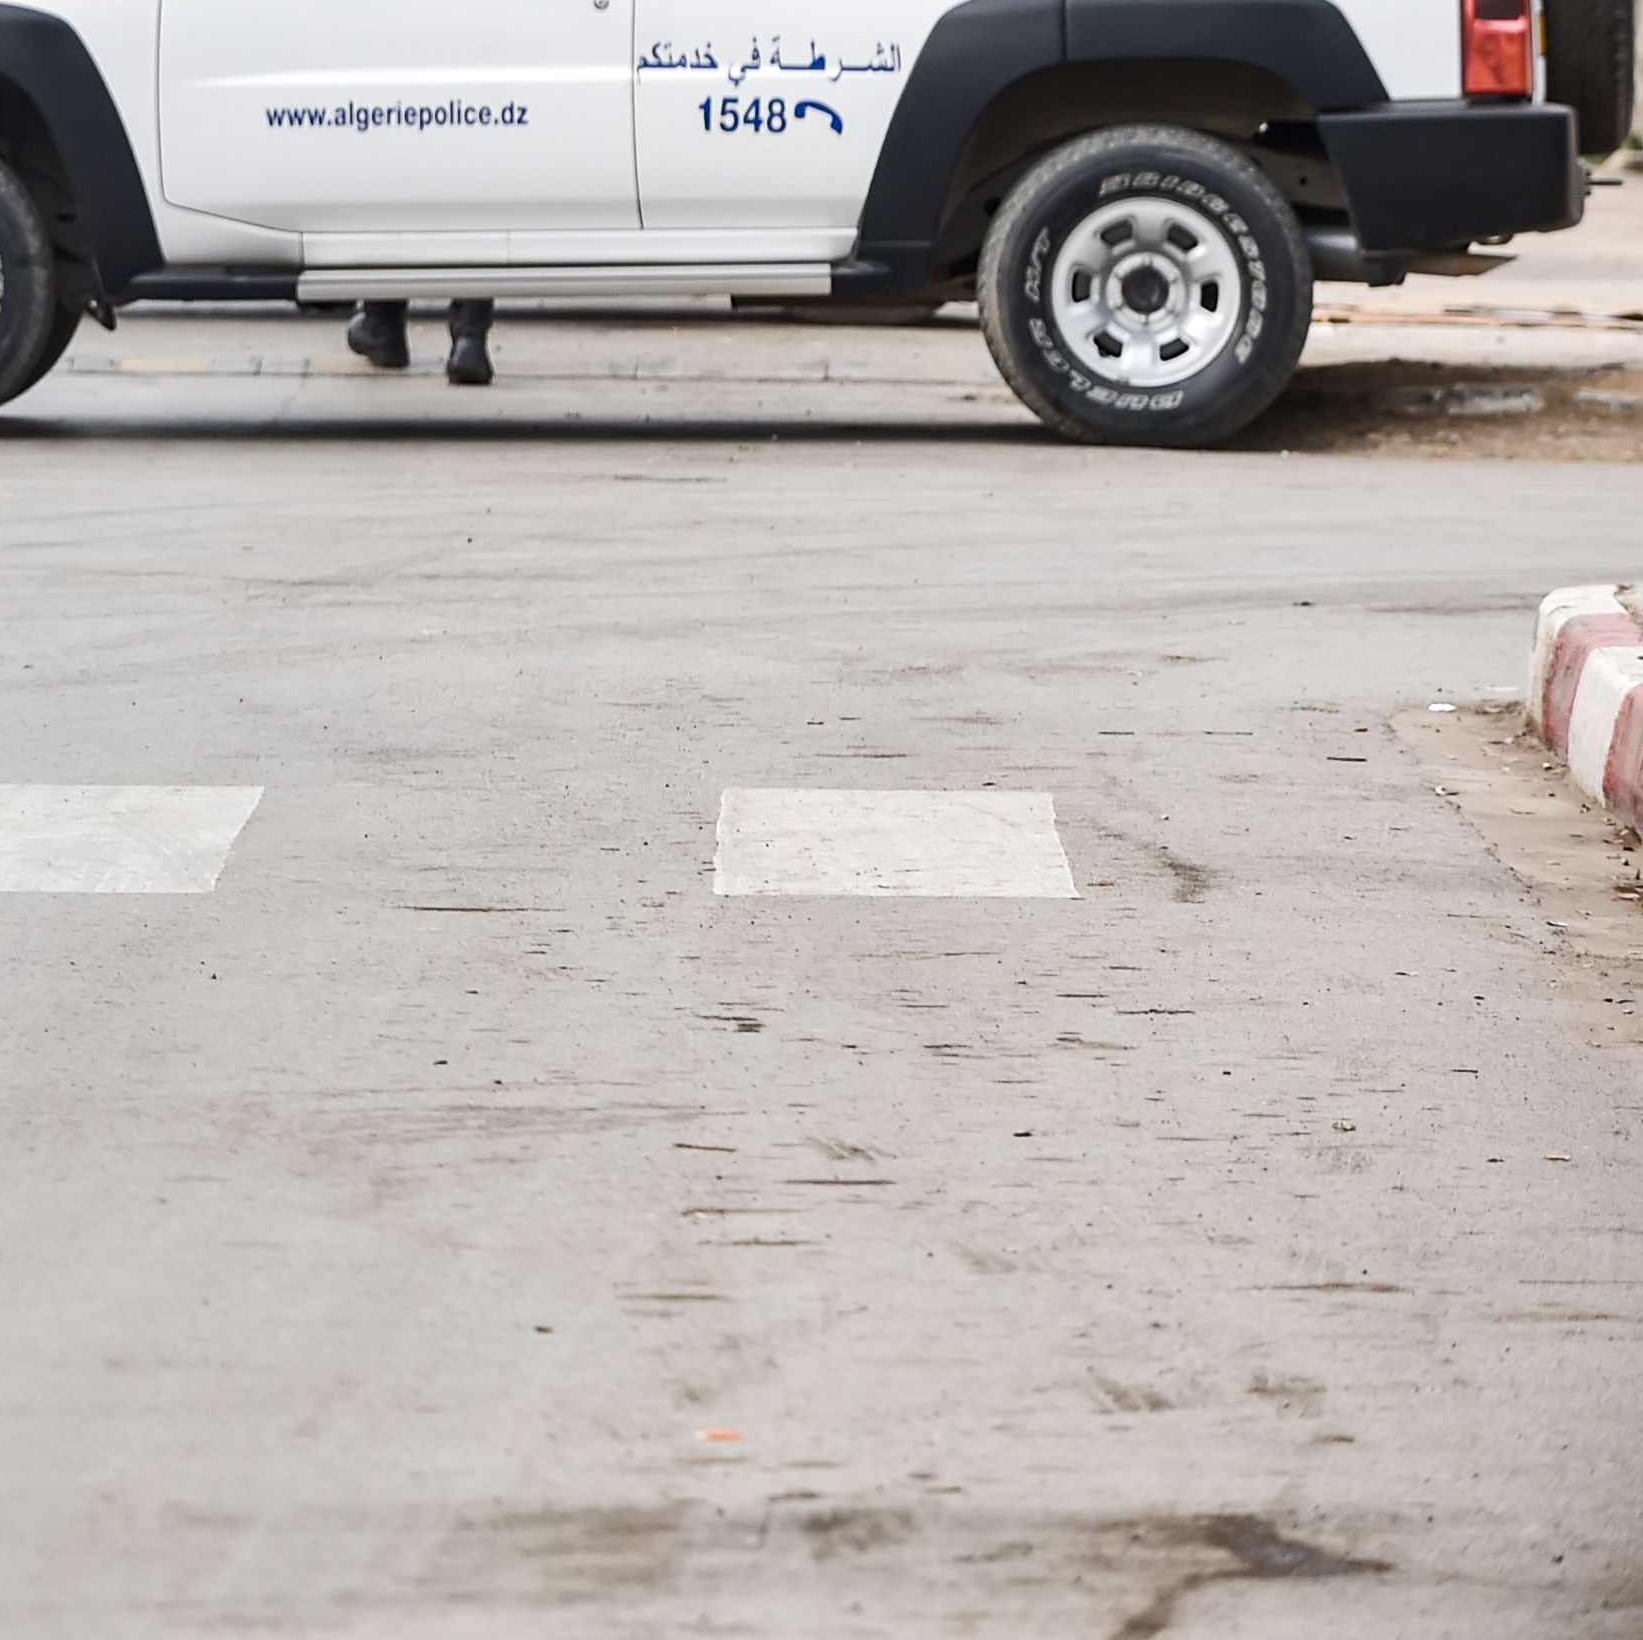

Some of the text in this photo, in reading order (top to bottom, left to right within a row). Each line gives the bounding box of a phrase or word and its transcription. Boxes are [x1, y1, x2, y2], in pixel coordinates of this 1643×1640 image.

[636, 42, 719, 83] خدمتكم
[727, 36, 761, 87] في
[266, 100, 529, 132] www.algeriepolice.dz
[699, 96, 787, 133] 1548
